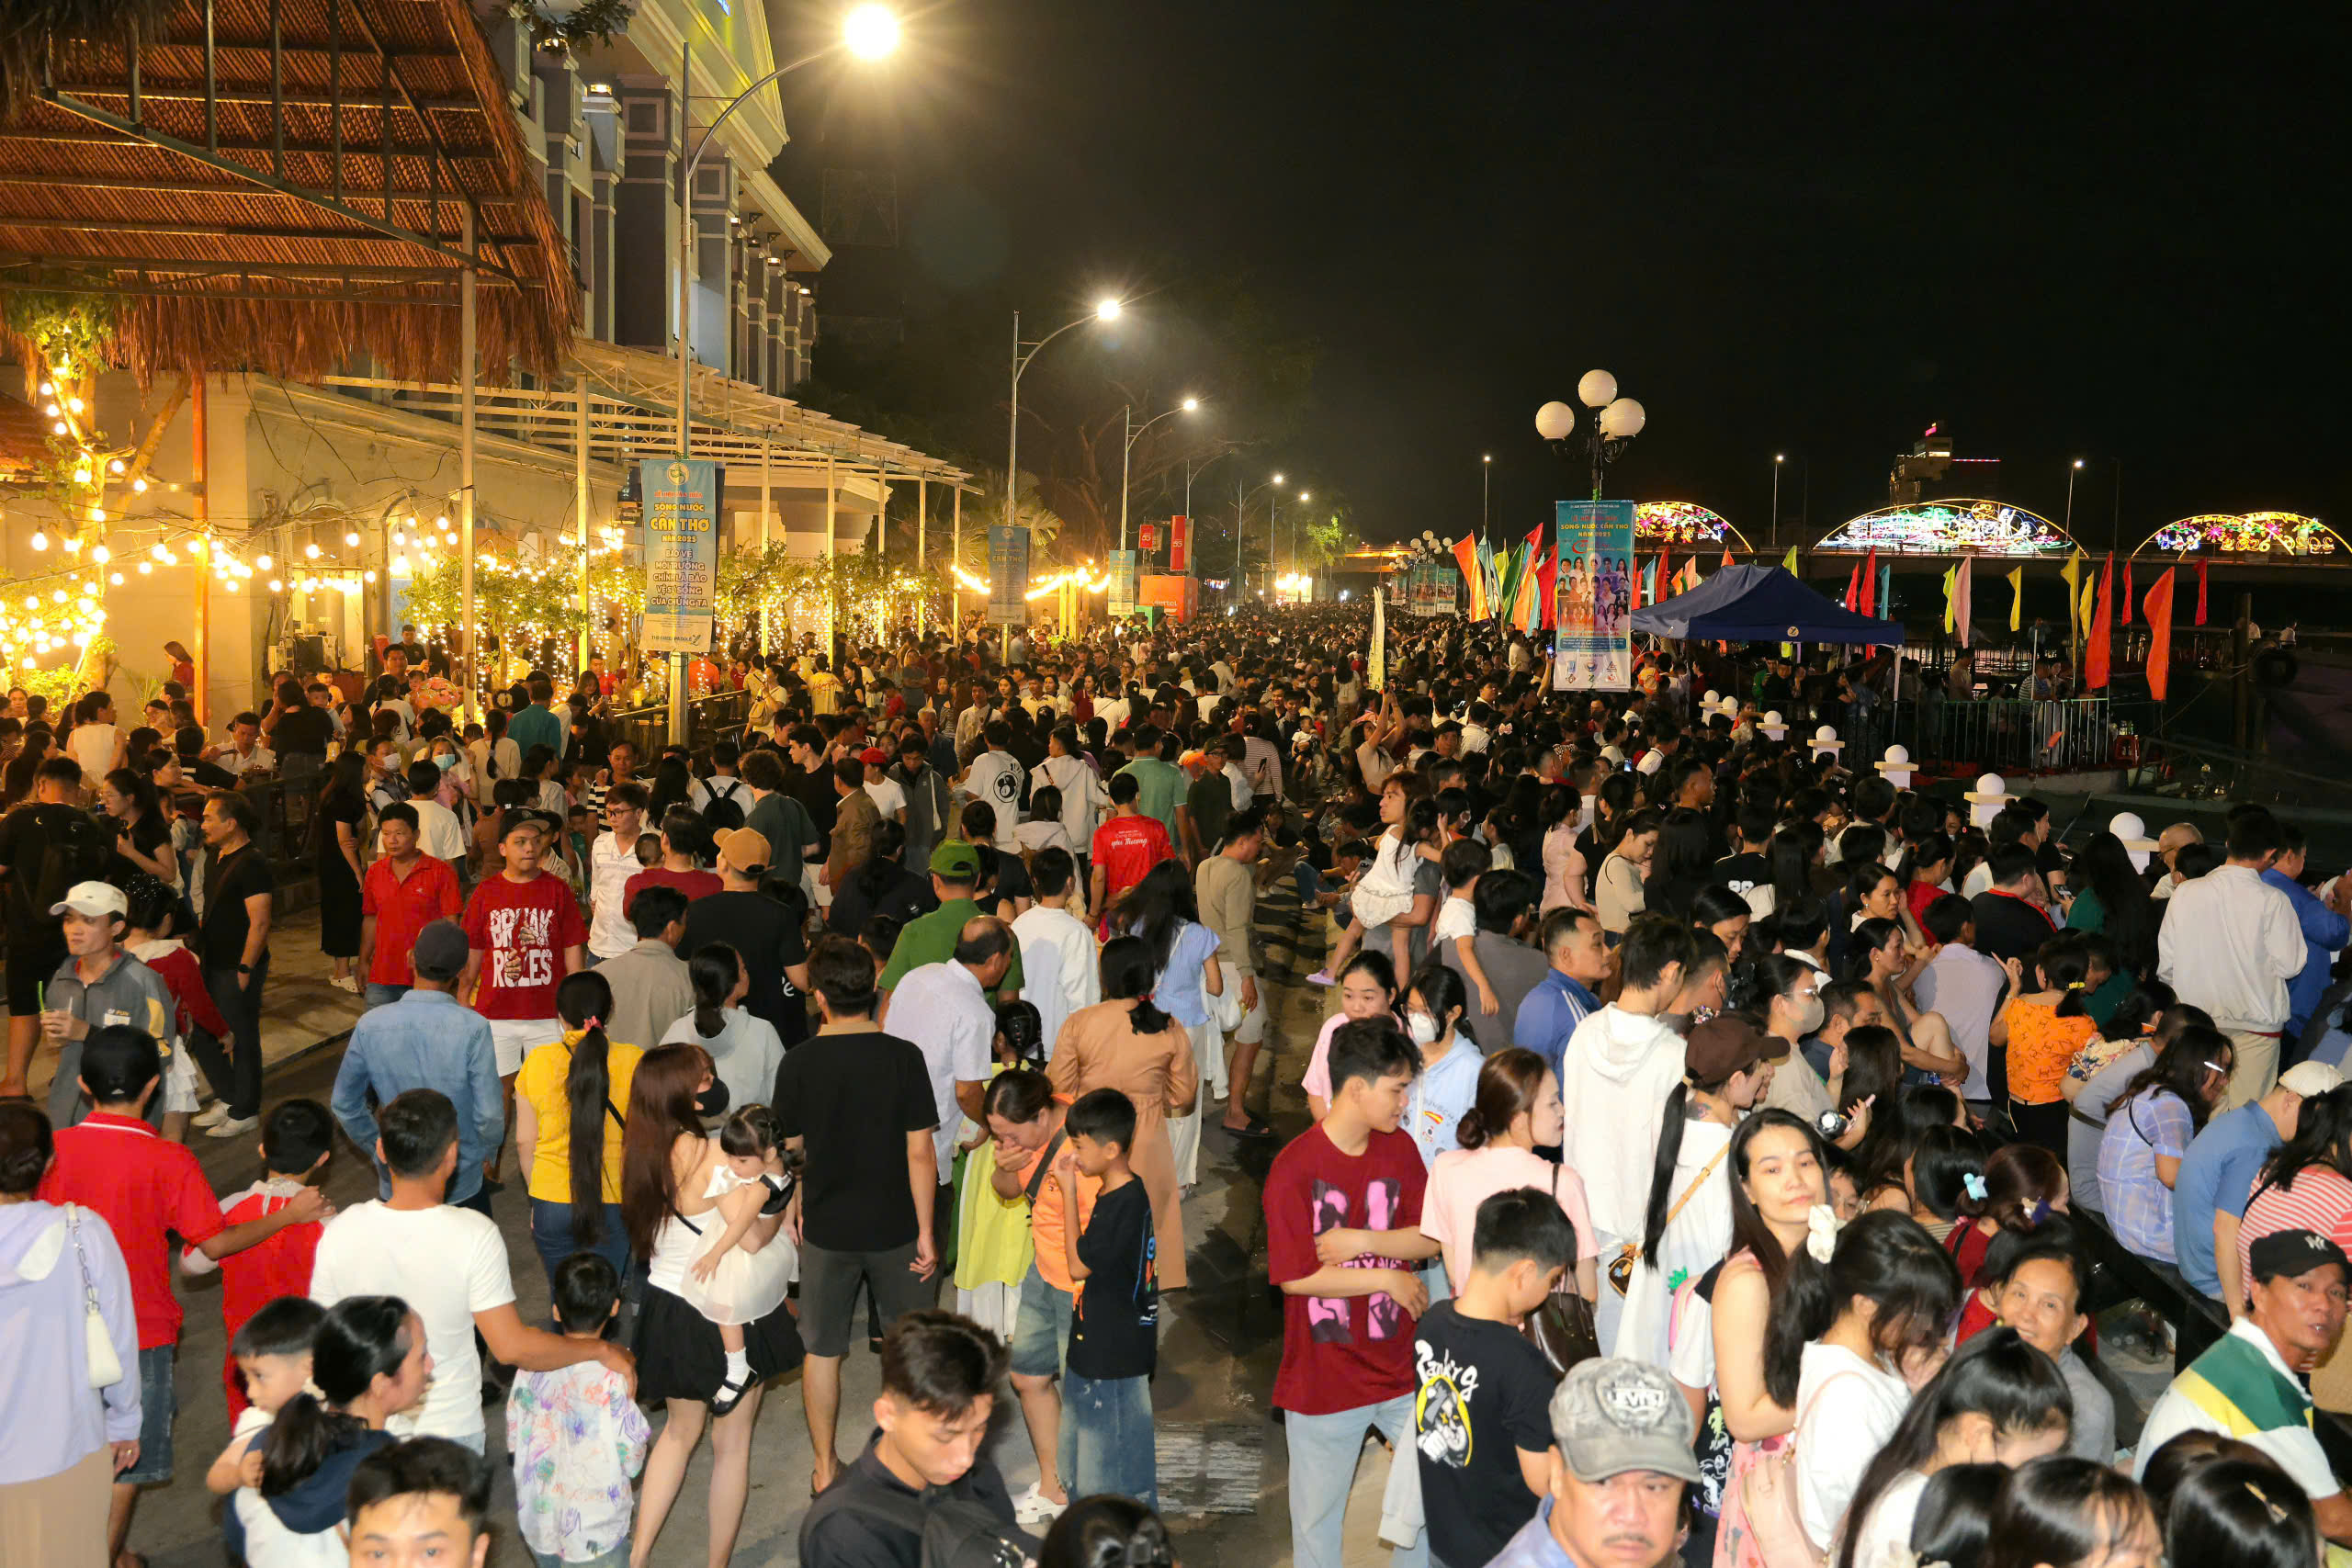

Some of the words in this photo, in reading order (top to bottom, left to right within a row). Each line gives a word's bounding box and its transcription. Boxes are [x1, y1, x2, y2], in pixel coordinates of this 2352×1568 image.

[654, 502, 677, 511] SÔNG
[679, 502, 705, 512] NƯỚC
[650, 512, 676, 532] CẦN
[679, 518, 710, 532] THƠ
[677, 535, 696, 543] 2025
[681, 548, 693, 559] VỆ
[655, 559, 670, 570] MÔI
[688, 572, 707, 583] BẢO
[656, 583, 667, 595] VỆ
[676, 583, 702, 595] SỐNG
[650, 595, 667, 605] CỦA
[667, 596, 695, 606] CHÚNG
[696, 599, 707, 607] TA
